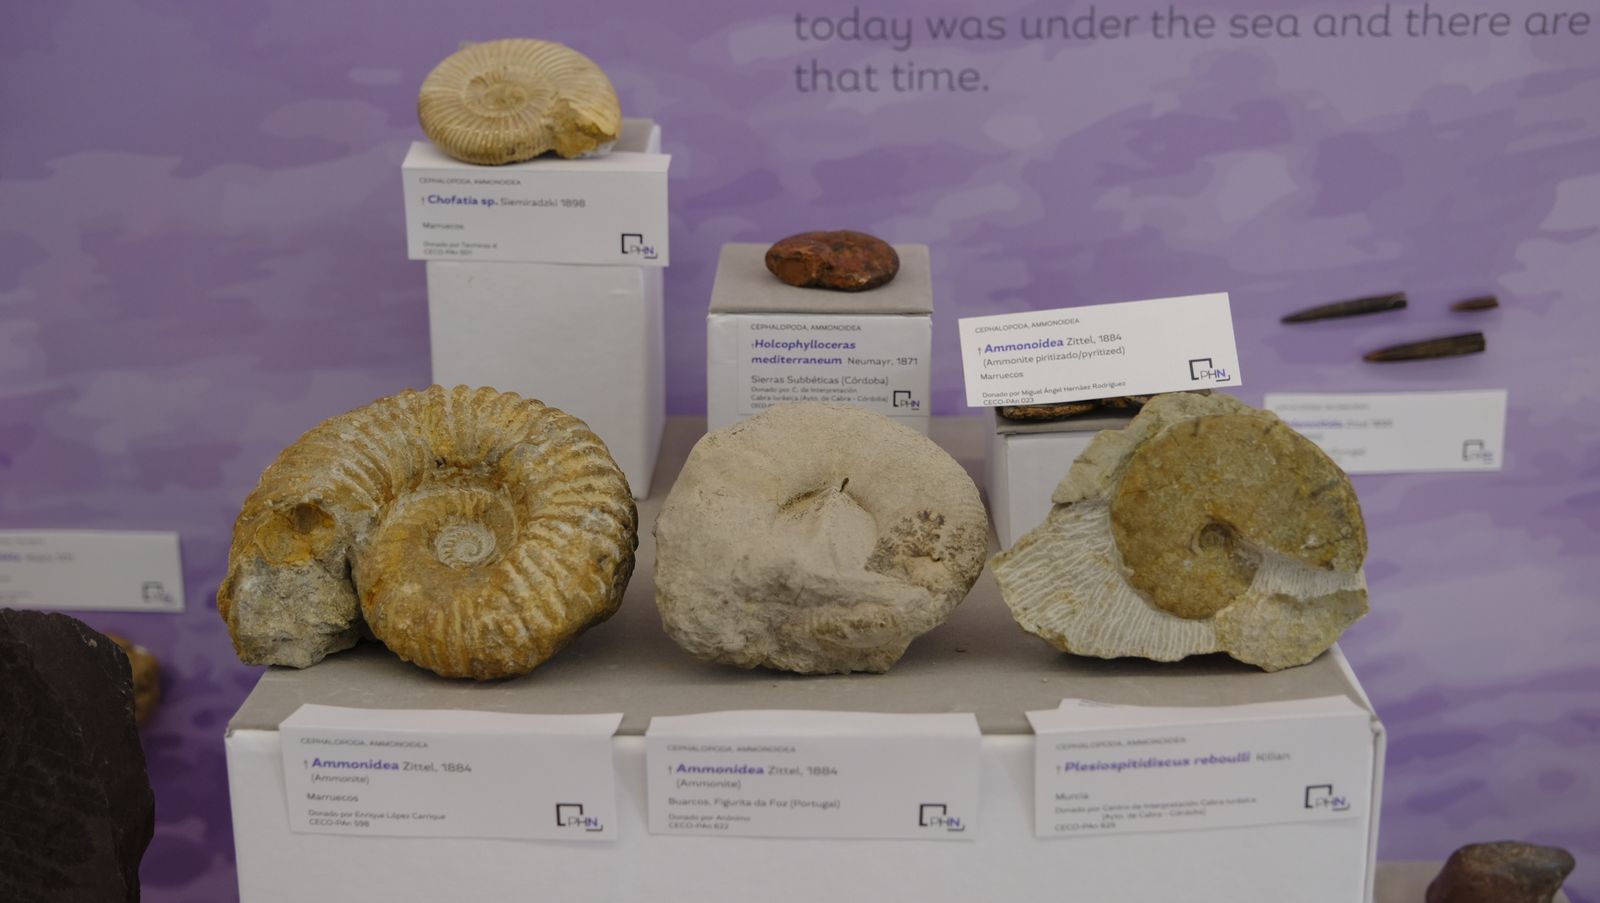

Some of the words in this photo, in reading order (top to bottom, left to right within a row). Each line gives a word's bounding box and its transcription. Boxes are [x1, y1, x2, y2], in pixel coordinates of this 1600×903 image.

[794, 4, 912, 50] today
[925, 13, 1006, 41] was
[1020, 6, 1139, 40] under
[1151, 6, 1215, 39] the
[1229, 14, 1300, 38] sea
[1313, 5, 1391, 38] and
[1404, 5, 1510, 37] there
[1525, 12, 1590, 36] are
[794, 61, 878, 93] that
[891, 61, 990, 93] time.
[427, 194, 478, 206] Chofatia
[480, 198, 498, 208] sp.
[559, 198, 586, 208] 1898
[750, 323, 808, 332] CEPHALOPODA,
[810, 324, 861, 332] AMMONOIDEA
[974, 323, 1029, 334] CEPHALOPODA,
[1031, 317, 1080, 328] AMMONOIDEA
[755, 338, 856, 351] Holcophylloceras
[984, 338, 1064, 353] Ammonoidea
[1066, 336, 1096, 347] Zittel,
[1098, 333, 1122, 343] 1884
[751, 355, 842, 365] mediterraneum
[897, 357, 918, 366] 1871
[983, 355, 1034, 368] (Ammonite
[1035, 345, 1126, 365] piritizado/pyritized)
[980, 371, 1024, 380] Marruecos
[1200, 368, 1226, 379] PHN
[751, 375, 784, 384] Sierras
[787, 375, 839, 384] Subbéticas
[841, 376, 889, 386] (Córdoba)
[982, 390, 1008, 398] Donado
[1009, 391, 1020, 399] por
[1021, 387, 1043, 397] Miguel
[1044, 385, 1062, 396] Ángel
[312, 757, 399, 770] Ammonidea
[403, 761, 438, 772] Zittel,
[441, 762, 472, 773] 1884
[676, 763, 764, 775] Ammonidea
[807, 766, 838, 776] 1884
[1064, 757, 1190, 773] Plesiospitidiscus
[311, 773, 369, 785] (Ammonite)
[676, 779, 742, 790] (Ammonite)
[307, 792, 358, 802] Marruecos
[790, 798, 840, 810] (Portugal)
[568, 816, 598, 827] PHN
[930, 816, 960, 828] PHN
